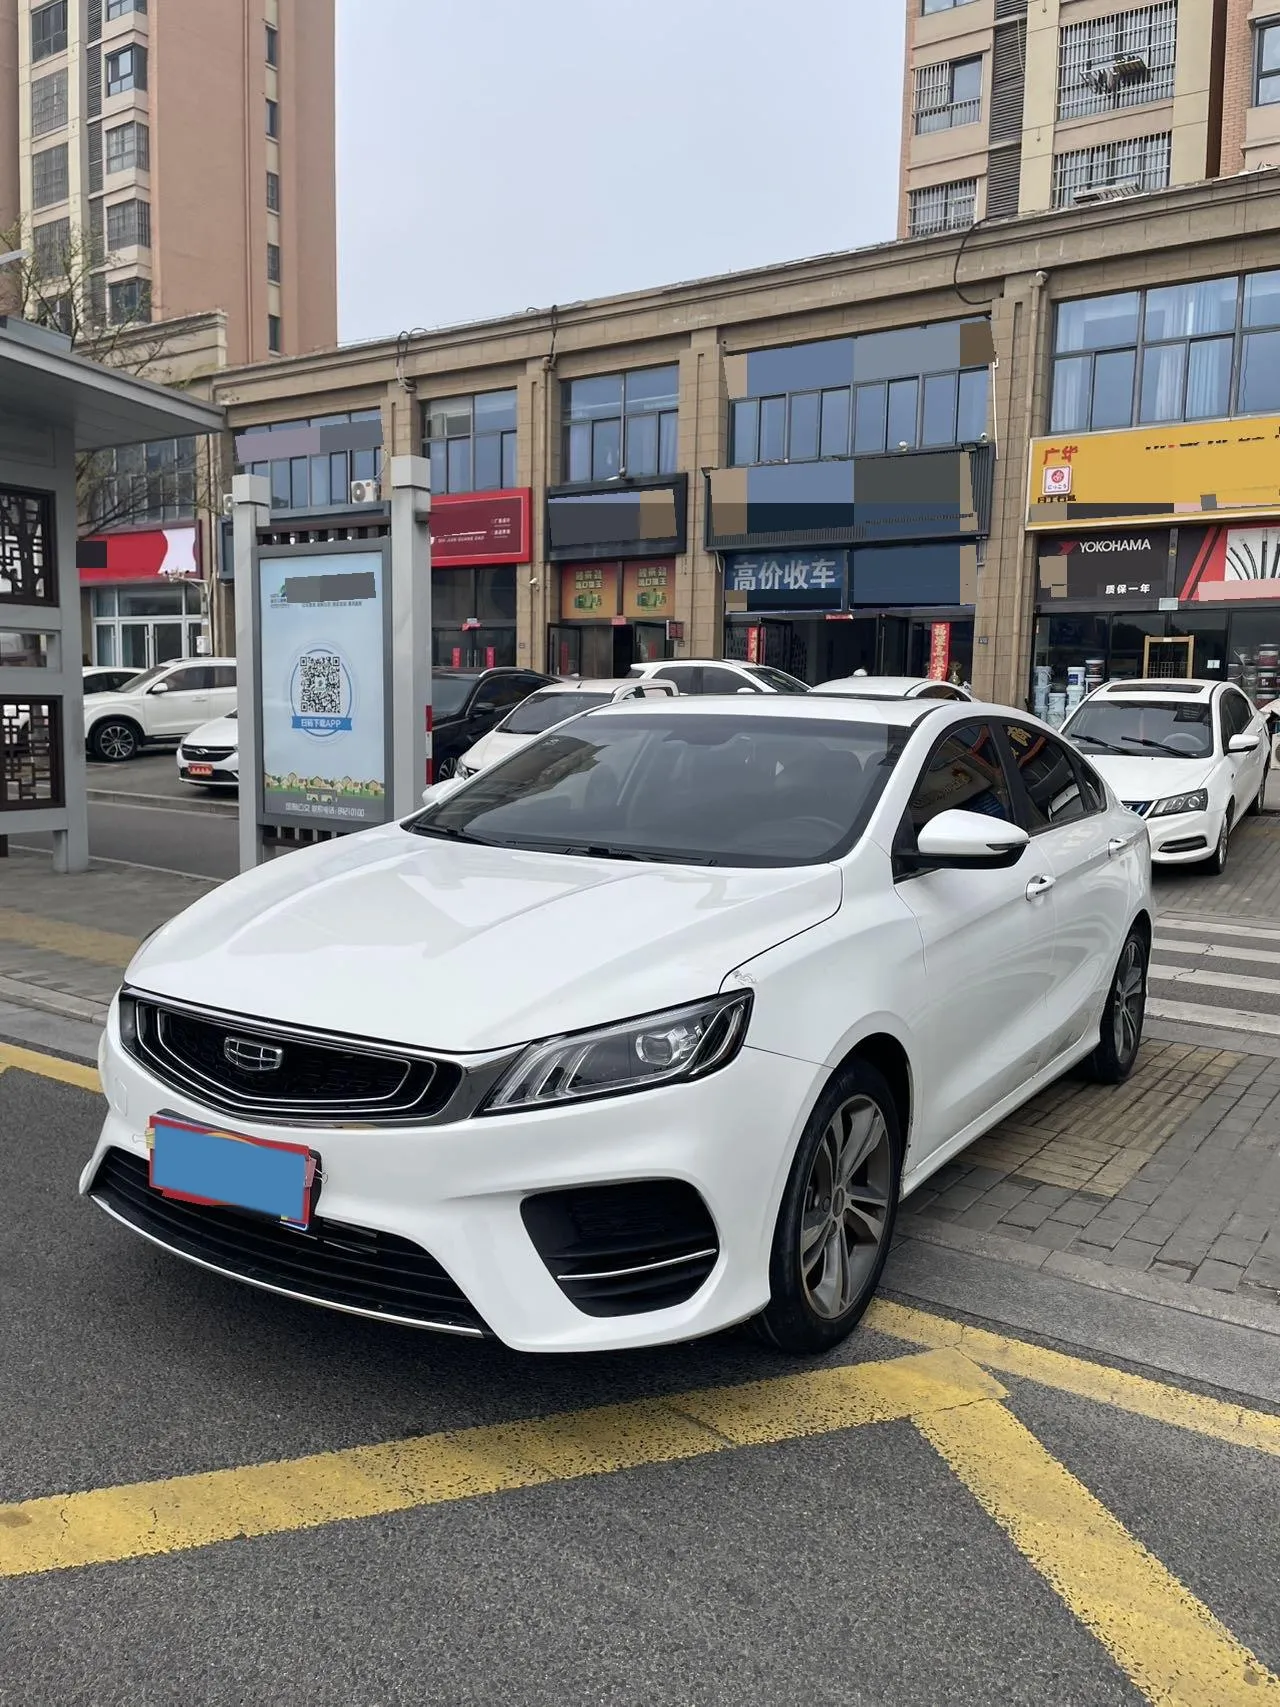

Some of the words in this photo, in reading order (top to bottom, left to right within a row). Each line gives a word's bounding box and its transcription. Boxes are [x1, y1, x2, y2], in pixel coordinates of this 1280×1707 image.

[1080, 539, 1151, 553] YOKOHAMA
[733, 558, 836, 591] 高价收车
[1105, 583, 1150, 595] 质保一年
